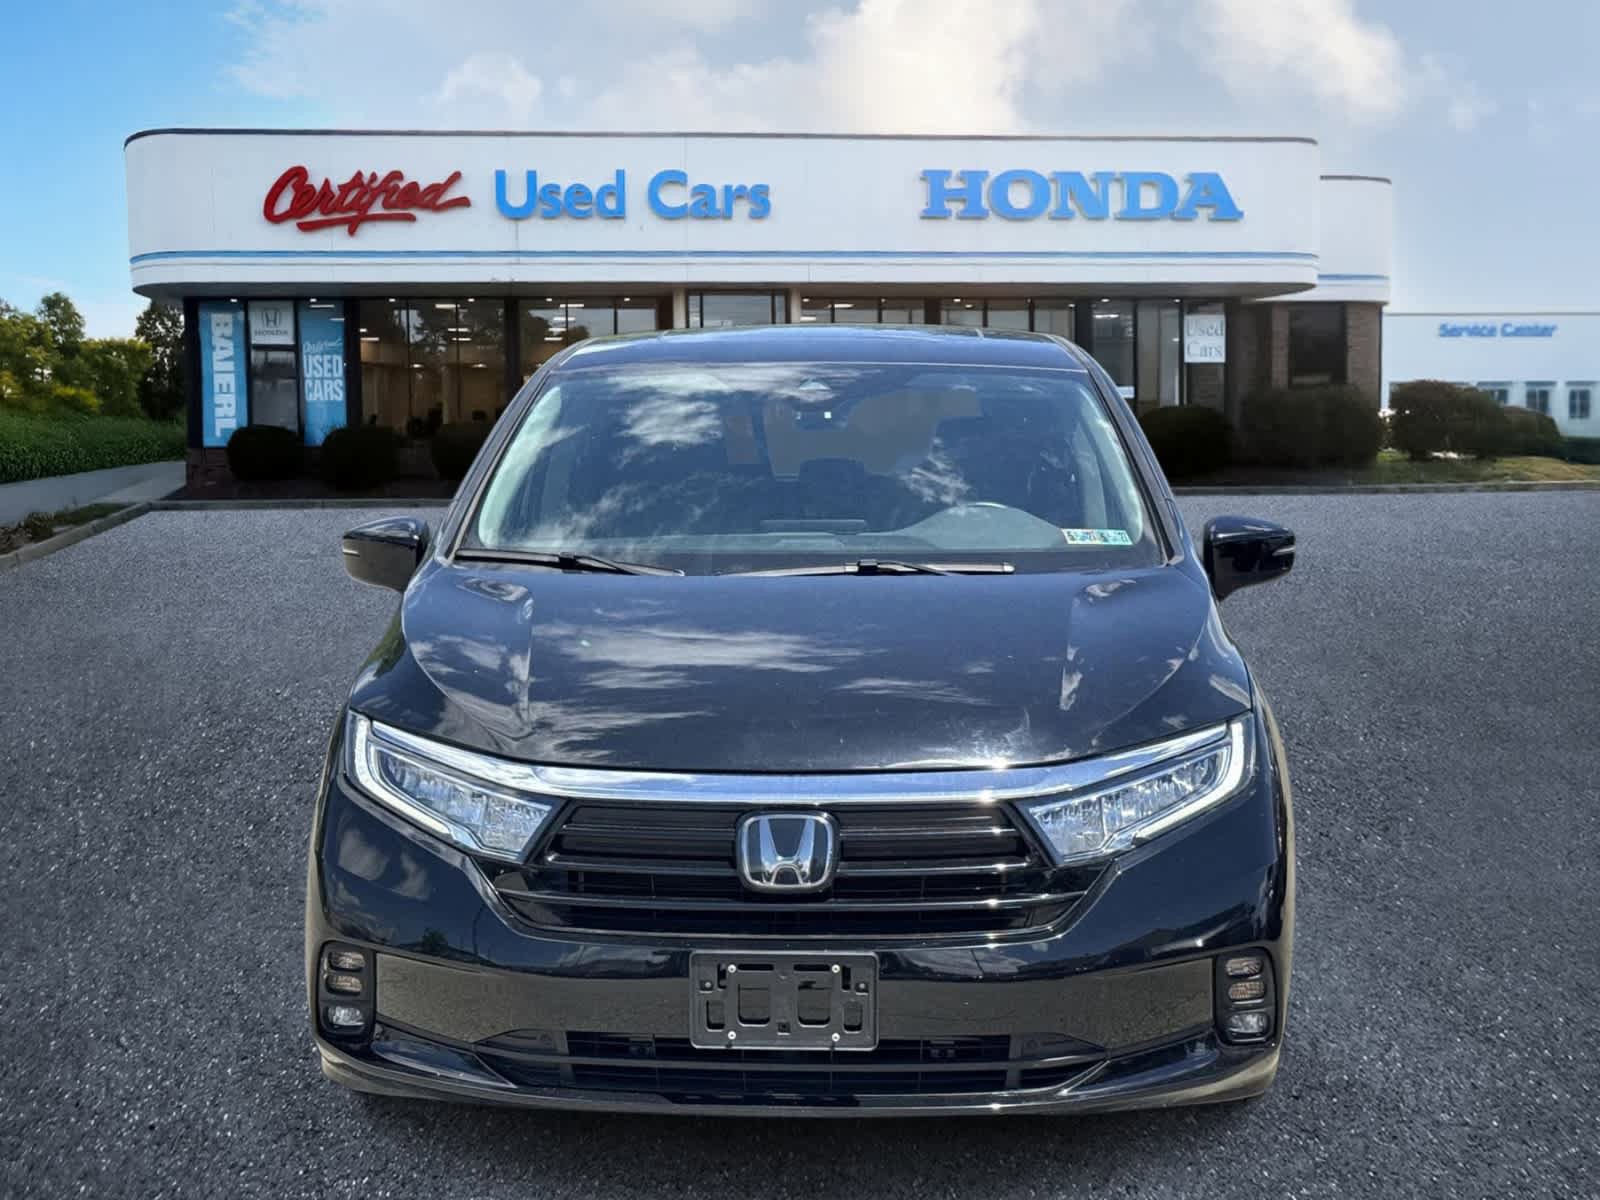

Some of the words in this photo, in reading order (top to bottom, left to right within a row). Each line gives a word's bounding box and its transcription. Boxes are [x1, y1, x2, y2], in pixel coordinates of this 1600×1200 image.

[264, 166, 471, 236] Certified
[495, 169, 625, 220] Used
[648, 169, 771, 220] Cars
[920, 169, 1244, 221] HONDA
[1186, 318, 1224, 337] Used
[1438, 322, 1497, 338] Service
[1501, 322, 1558, 338] Center
[1186, 340, 1223, 358] Cars
[211, 313, 237, 438] BAIERL
[303, 354, 344, 378] USED
[304, 379, 344, 402] CARS
